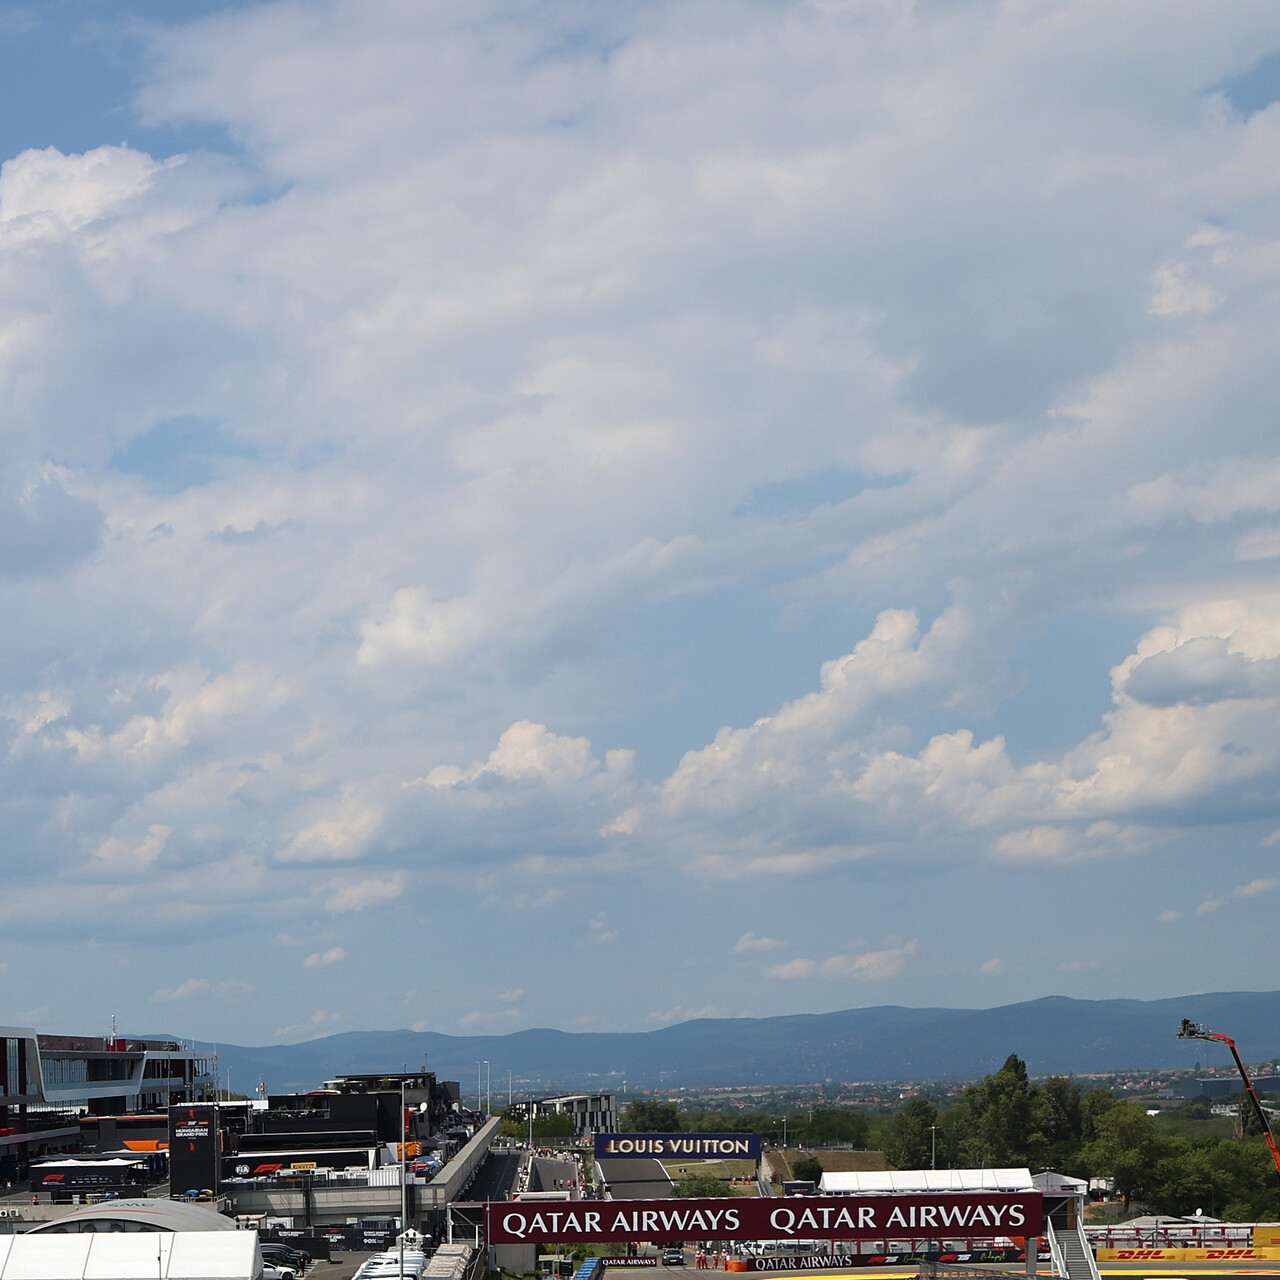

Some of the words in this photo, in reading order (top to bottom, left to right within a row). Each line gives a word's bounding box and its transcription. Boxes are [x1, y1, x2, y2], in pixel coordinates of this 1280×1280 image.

[608, 1138, 664, 1155] LOUIS
[667, 1138, 750, 1155] VUITTON
[502, 1212, 603, 1238] QATAR
[610, 1209, 740, 1233] AIRWAYS
[769, 1207, 877, 1233] QATAR
[884, 1204, 1025, 1229] AIRWAYS
[602, 1258, 627, 1266] QATAR
[628, 1258, 656, 1266] AIRWAYS
[1117, 1250, 1166, 1259] DHL
[1205, 1249, 1257, 1259] DHL
[755, 1258, 797, 1271] QATAR
[799, 1255, 852, 1268] AIRWAYS
